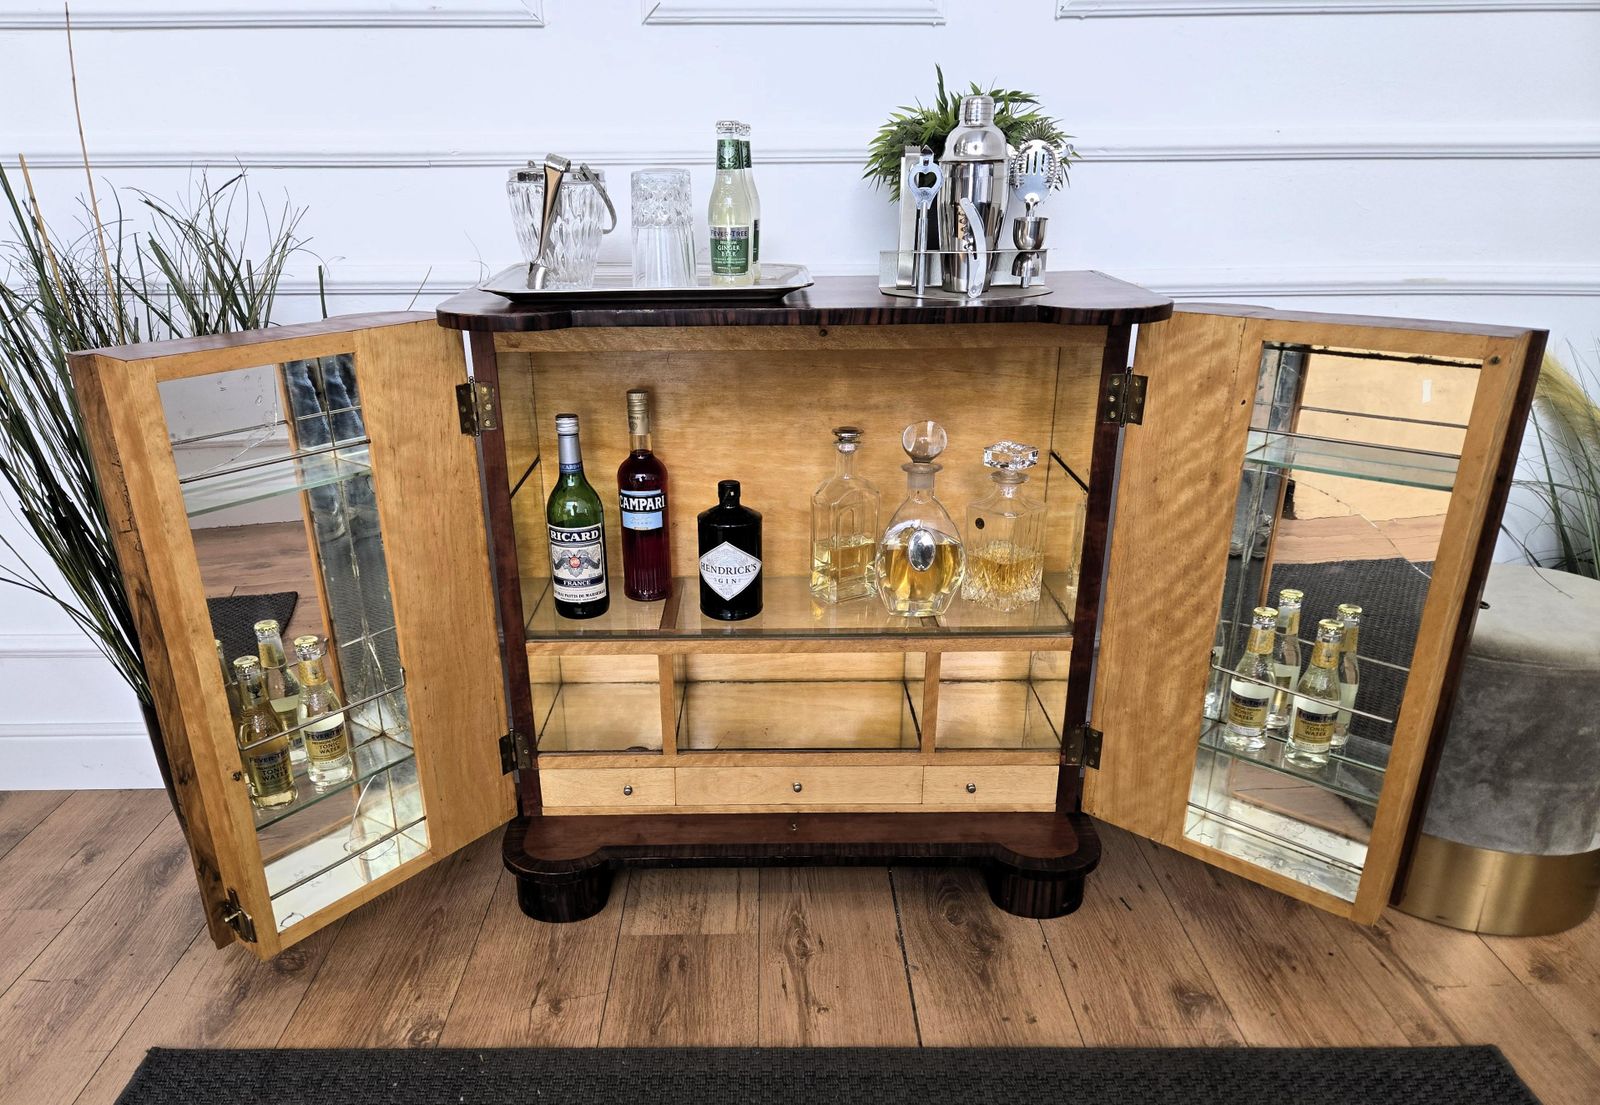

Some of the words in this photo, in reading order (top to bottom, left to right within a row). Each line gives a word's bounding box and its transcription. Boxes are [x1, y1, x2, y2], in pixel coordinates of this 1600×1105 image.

[619, 495, 665, 511] CAMPARI
[550, 530, 600, 542] RICARD
[700, 561, 757, 575] HENDRICK'S
[320, 741, 339, 749] TONIC
[320, 745, 340, 754] WATER
[262, 764, 287, 775] TONIC
[262, 769, 288, 781] WATER
